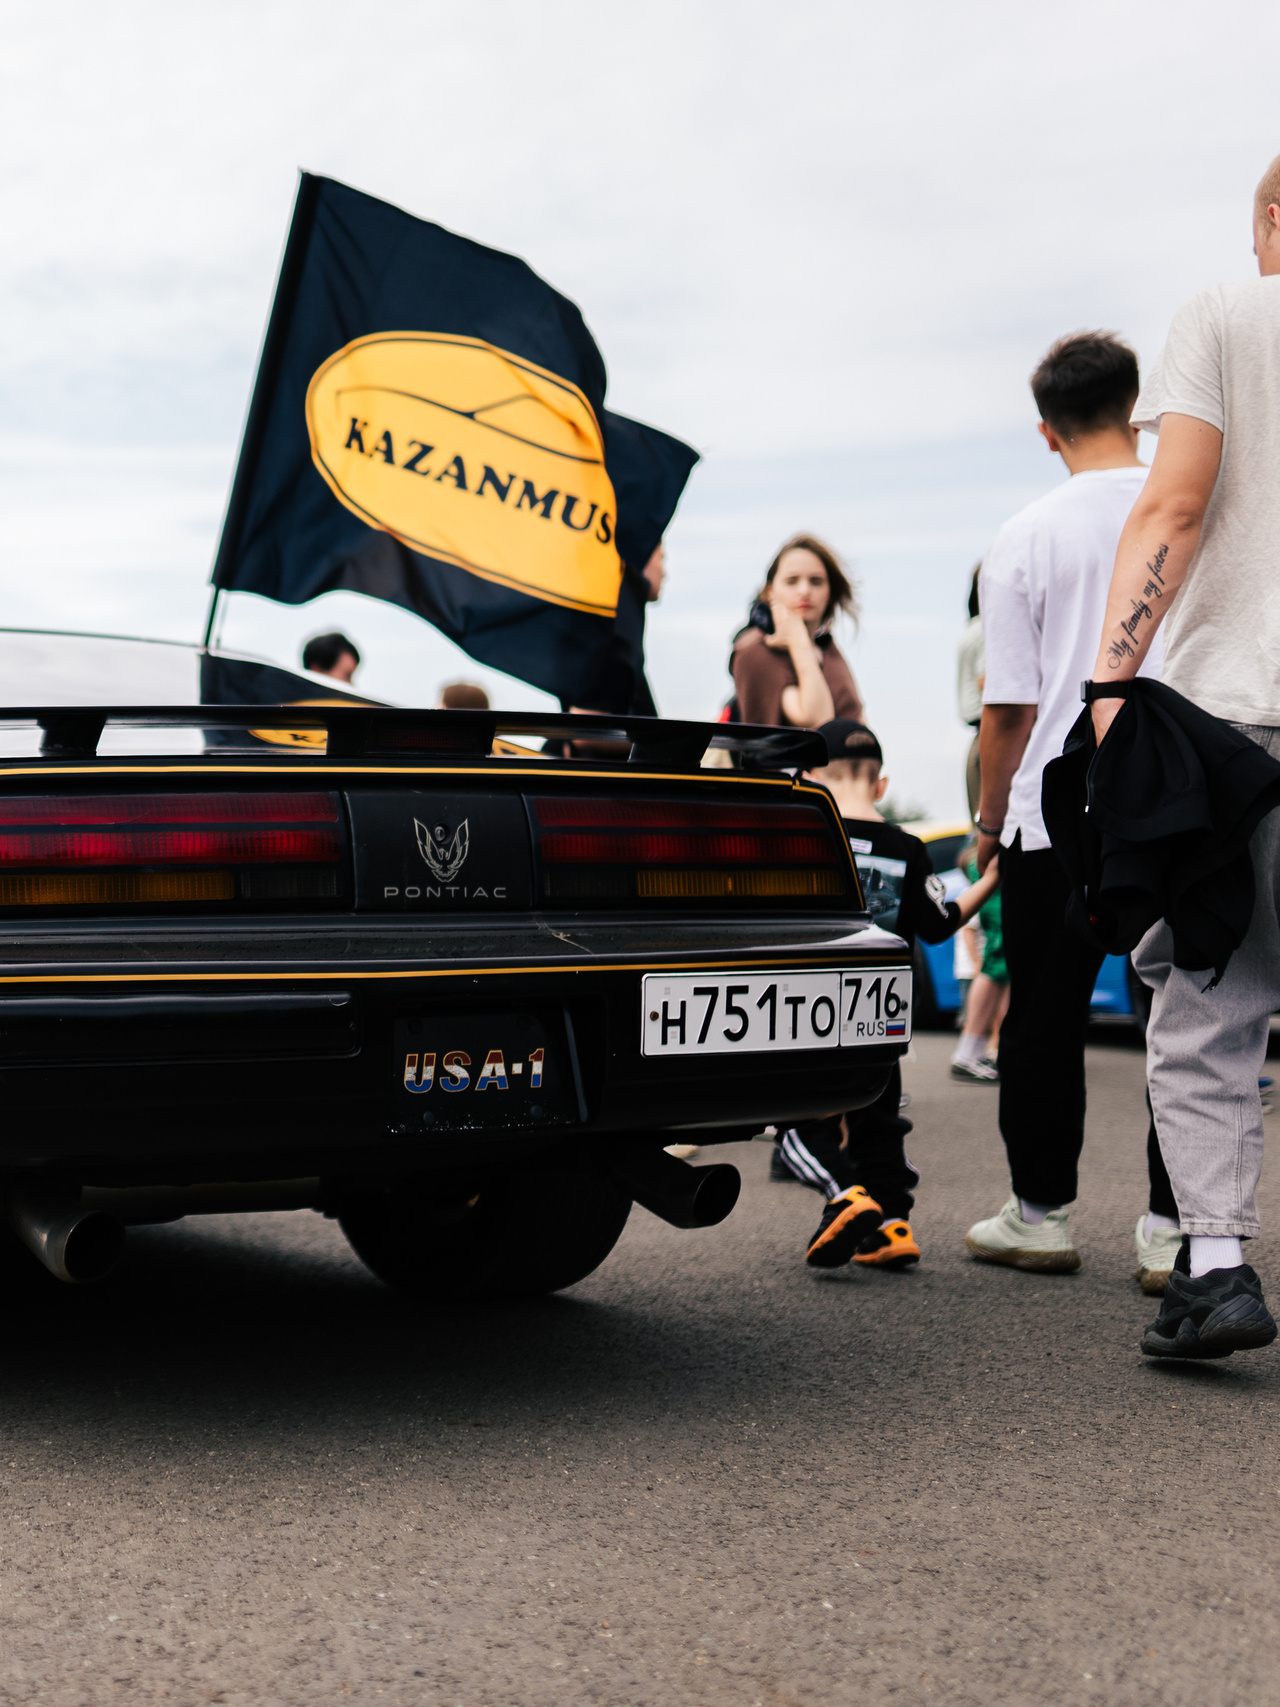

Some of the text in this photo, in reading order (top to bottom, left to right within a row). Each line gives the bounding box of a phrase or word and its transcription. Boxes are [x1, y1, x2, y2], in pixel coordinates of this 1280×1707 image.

[345, 417, 613, 544] KAZANMUS
[1143, 579, 1162, 598] my
[1120, 599, 1152, 645] family
[1106, 639, 1135, 669] My
[383, 886, 507, 898] PONTIAC
[844, 977, 901, 1022] 716
[856, 1021, 885, 1037] RUS
[403, 1048, 545, 1093] USA-1
